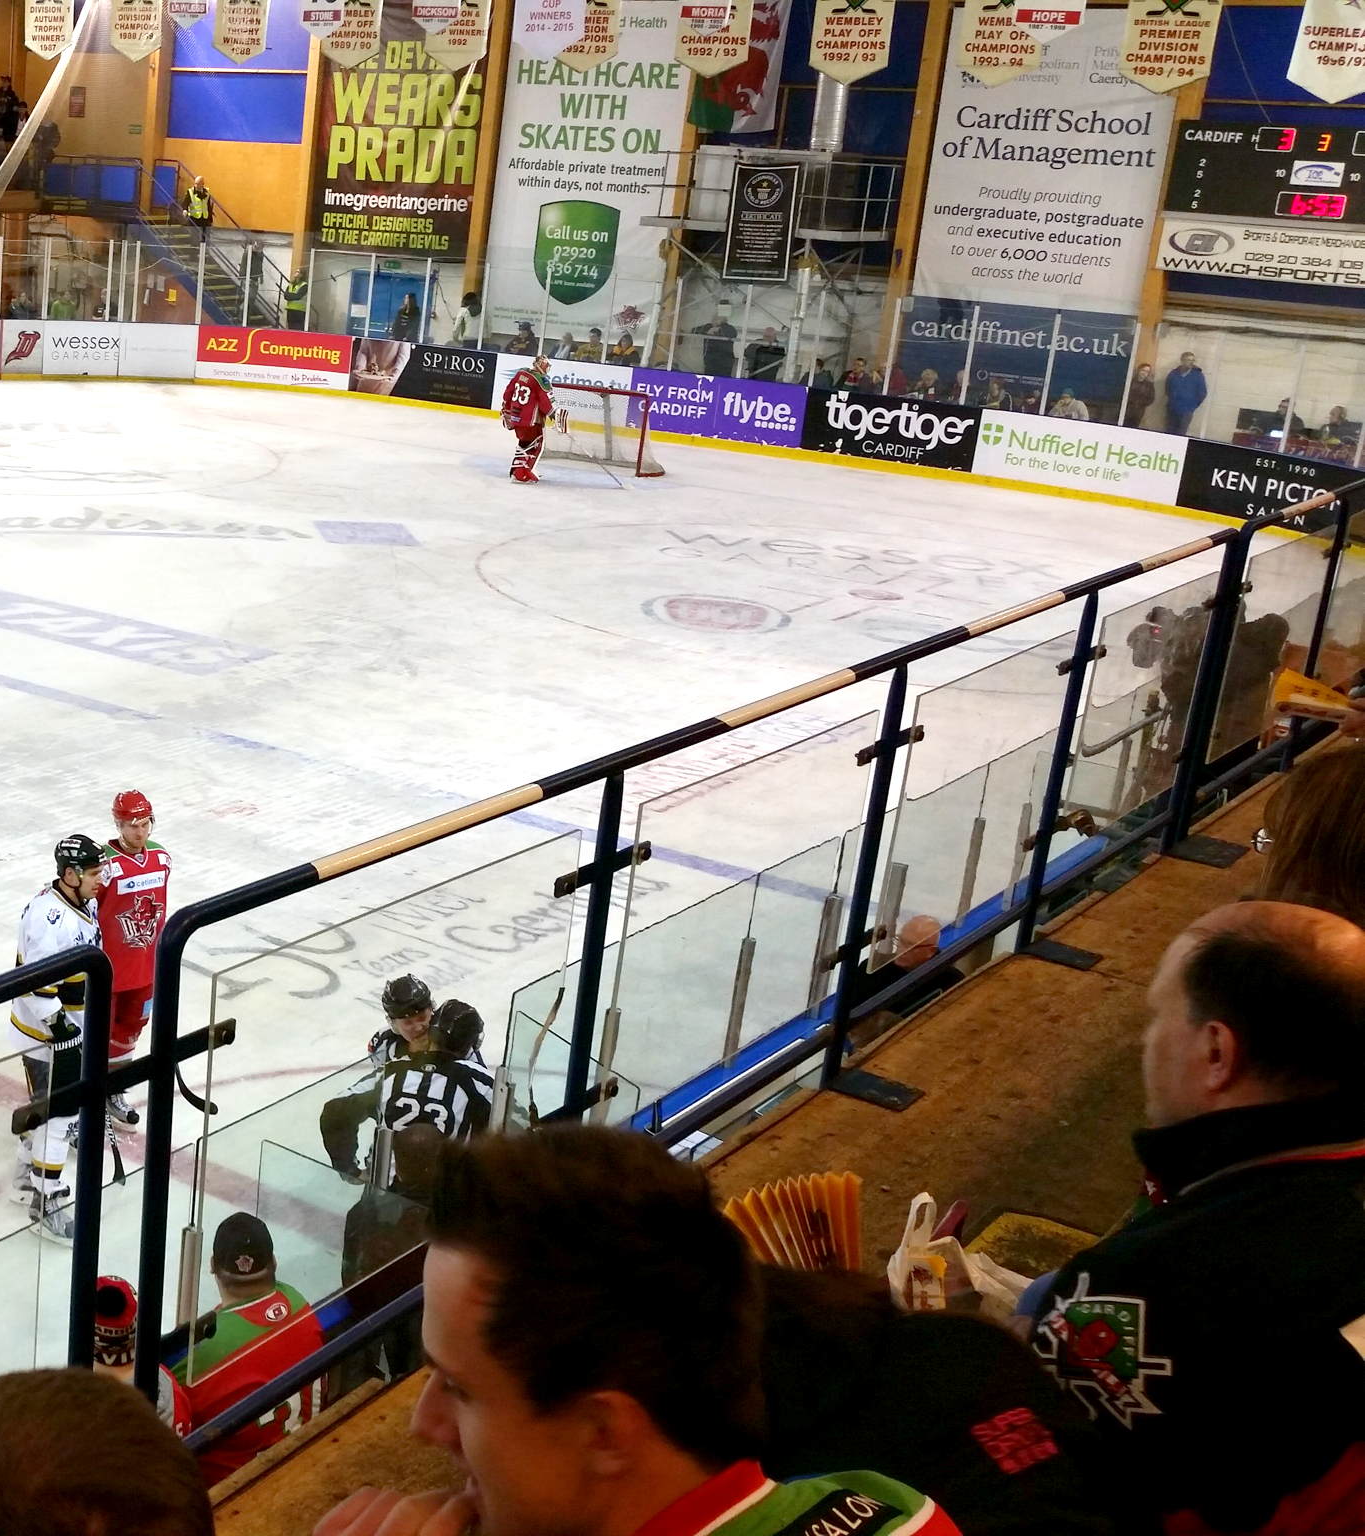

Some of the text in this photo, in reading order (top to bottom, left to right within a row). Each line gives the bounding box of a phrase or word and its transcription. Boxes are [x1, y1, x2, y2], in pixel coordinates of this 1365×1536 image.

[171, 3, 205, 13] LAWLESS
[416, 8, 455, 17] DICKSON
[542, 0, 561, 8] CUP
[691, 7, 725, 18] MORIA
[311, 12, 333, 20] STONE
[529, 11, 572, 20] WINNERS
[629, 16, 668, 29] Health
[826, 17, 884, 26] WEMBLEY
[978, 17, 1017, 26] WEMB
[1031, 12, 1066, 23] HOPE
[115, 23, 159, 31] CHAMPIONS
[553, 23, 573, 32] 2015
[823, 29, 881, 38] PLAY OFF
[975, 30, 1031, 40] PLAY OFF
[1139, 30, 1201, 40] PREMIER
[223, 36, 261, 45] WINNERS
[681, 35, 747, 45] CHAMPIONS
[816, 41, 886, 50] CHAMPIONS
[965, 43, 1035, 54] CHAMPIONS
[1139, 42, 1199, 52] DIVISION
[594, 45, 607, 54] 93
[822, 52, 876, 62] 1992 93
[972, 57, 1023, 67] 1993 94
[1125, 53, 1206, 65] CHAMPIONS
[1133, 66, 1194, 77] 1993 94
[333, 72, 483, 127] WEARS
[560, 93, 627, 120] WITH
[957, 106, 1152, 136] Cardiff School
[518, 123, 661, 154] SKATES ON
[1185, 129, 1244, 144] CARDIFF
[1277, 129, 1296, 150] 3
[1317, 134, 1332, 152] 3
[327, 126, 477, 185] PRADA
[942, 136, 1156, 169] of Management
[509, 158, 665, 177] Affordable private treatment
[518, 176, 650, 194] within days, not months.
[324, 188, 468, 215] limegreentangerine
[979, 186, 1101, 208] Proudly providing
[323, 212, 433, 233] OFFICIAL DESIGNERS
[934, 204, 1144, 229] undergraduate, postgraduate
[322, 228, 449, 250] TO THE CARDIFF DEVILS
[545, 225, 608, 242] Call us on
[947, 223, 1122, 247] and executive education
[553, 246, 596, 261] 02920
[951, 244, 1111, 267] to over 6,000 students
[1245, 252, 1364, 270] 029 20 384 108
[546, 259, 598, 280] 836 714
[971, 264, 1083, 285] across the world
[52, 335, 120, 350] wessex
[206, 337, 341, 365] A2Z Computing
[51, 351, 120, 362] GARAGES
[423, 352, 485, 373] SPIROS
[213, 368, 281, 381] Smooth, stress free
[301, 373, 329, 383] Problem
[512, 383, 531, 404] 33
[637, 383, 713, 403] FLY FROM
[638, 402, 708, 419] CARDIFF
[722, 389, 797, 422] flybe.
[825, 390, 975, 450] tigertiger
[861, 439, 926, 458] CARDIFF
[1008, 429, 1179, 475] Nuffield Health
[1005, 452, 1101, 480] For the love of
[1255, 457, 1315, 477] EST. 1990
[1211, 468, 1257, 494] KEN
[665, 529, 1063, 580] wessex
[54, 1036, 83, 1051] WARR
[392, 1096, 449, 1134] 23
[811, 1493, 885, 1536] SALON
